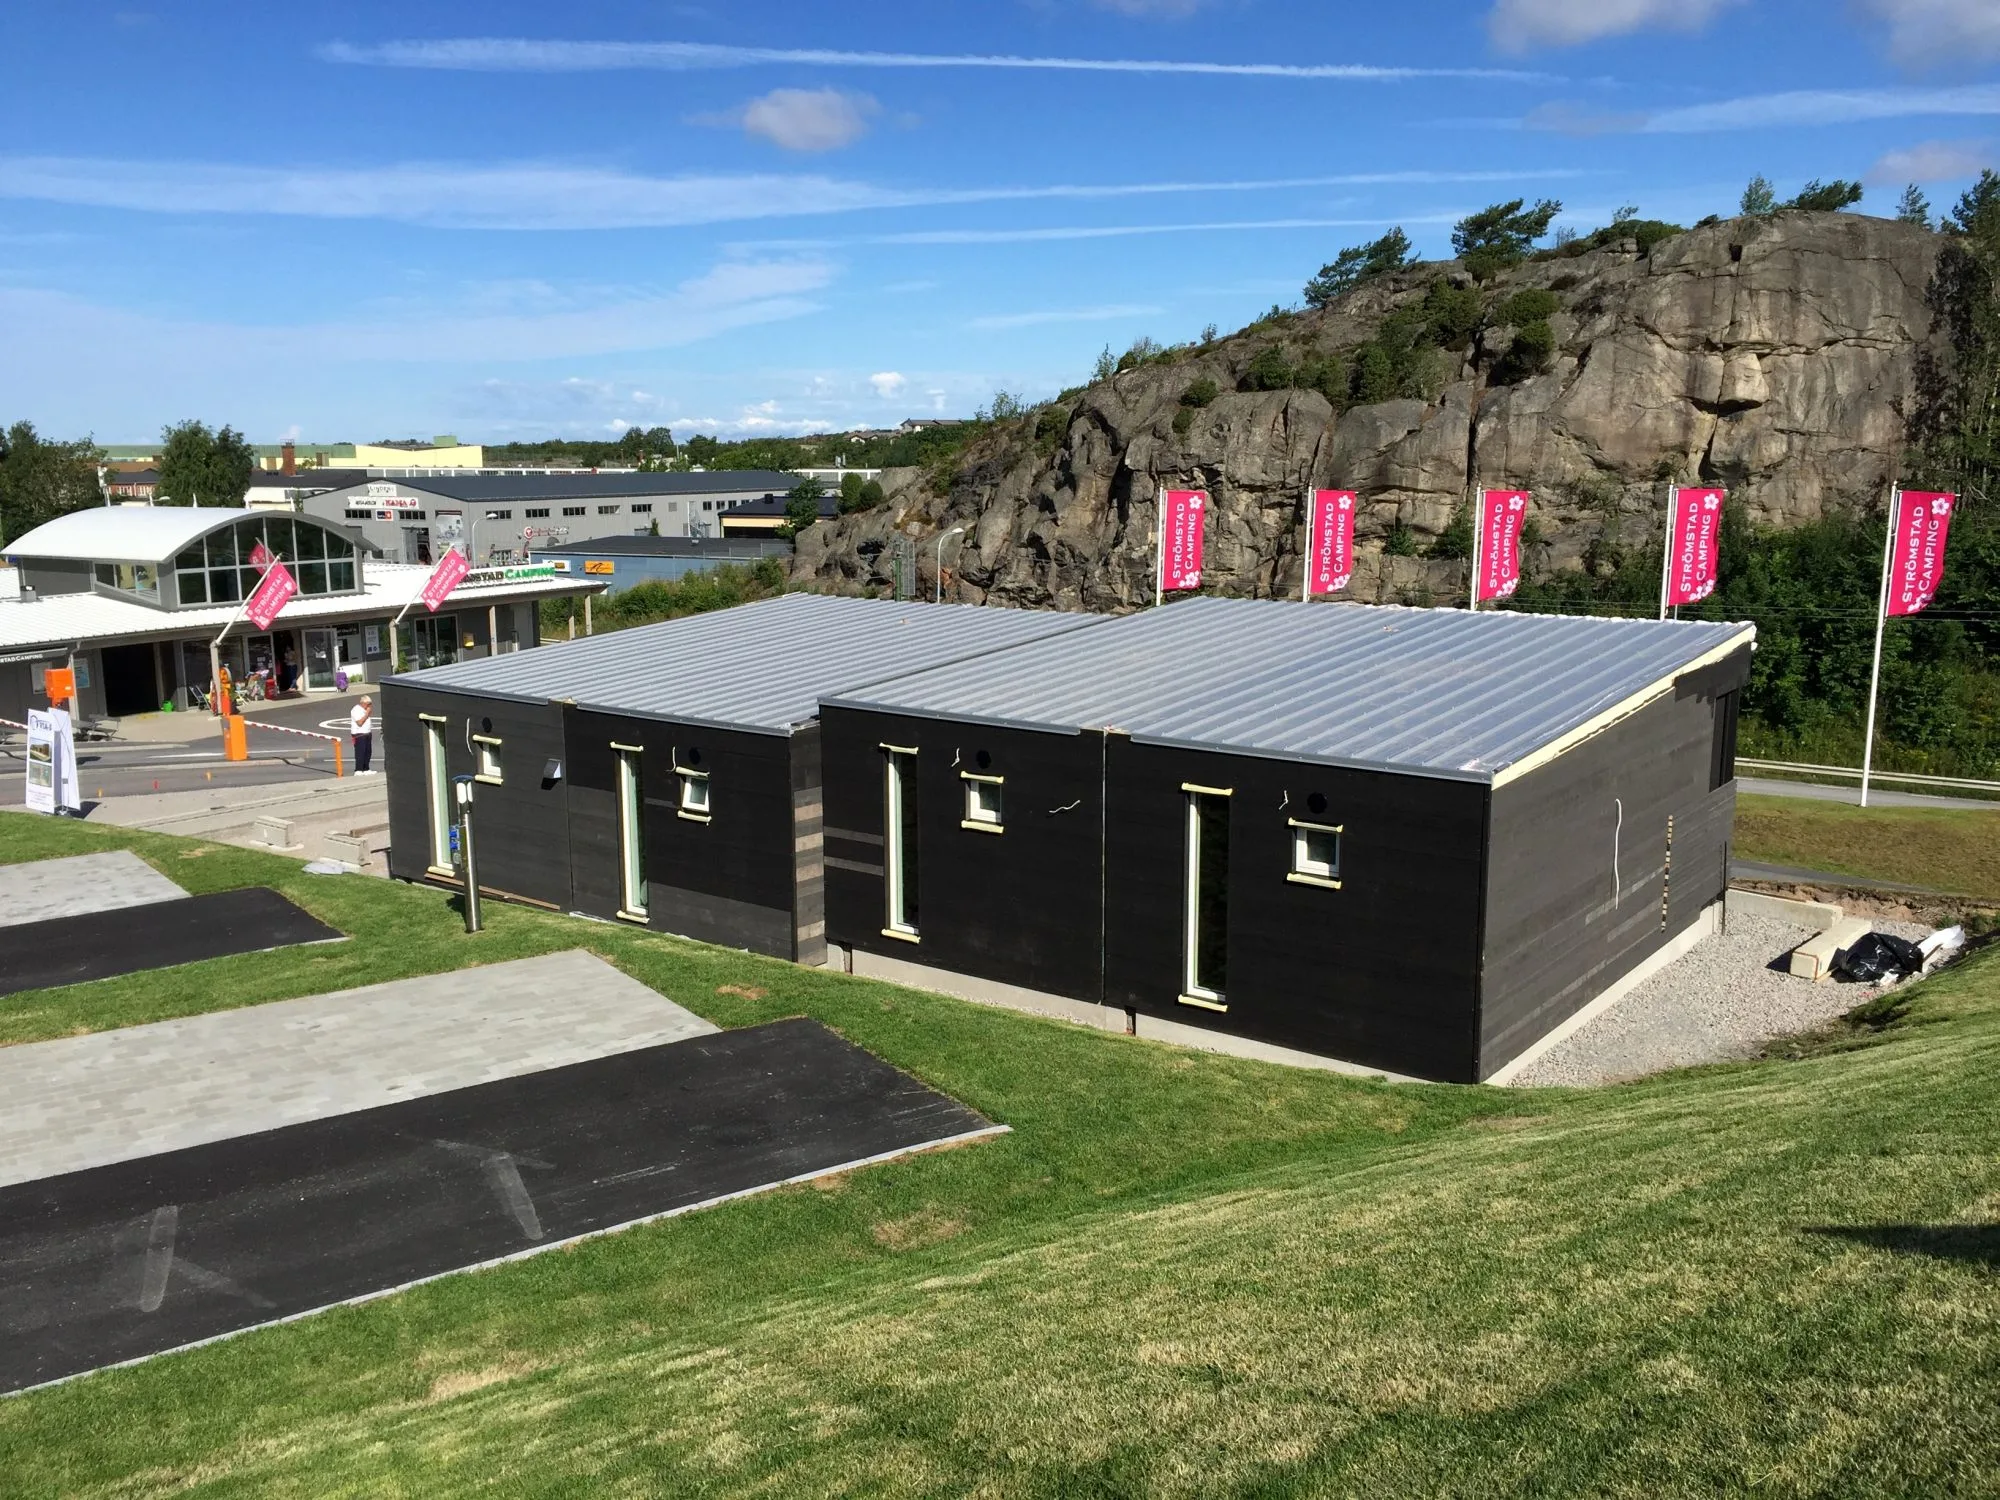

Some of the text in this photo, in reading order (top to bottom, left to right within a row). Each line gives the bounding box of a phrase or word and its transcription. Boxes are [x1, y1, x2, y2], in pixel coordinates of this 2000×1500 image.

[504, 566, 556, 581] CAMPING
[1172, 503, 1185, 579] STRÖMSTAD
[1185, 513, 1197, 570] CAMPING
[1320, 502, 1334, 583] STRÖMSTAD
[1333, 513, 1345, 573] CAMPING
[1489, 503, 1503, 588] STRÖMSTAD
[1501, 514, 1515, 578] CAMPING
[1680, 502, 1698, 592] STRÖMSTAD
[1697, 514, 1711, 580] CAMPING
[1902, 506, 1924, 602] STRÖMSTAD
[1918, 520, 1939, 591] CAMPING
[15, 653, 44, 662] CAMPING
